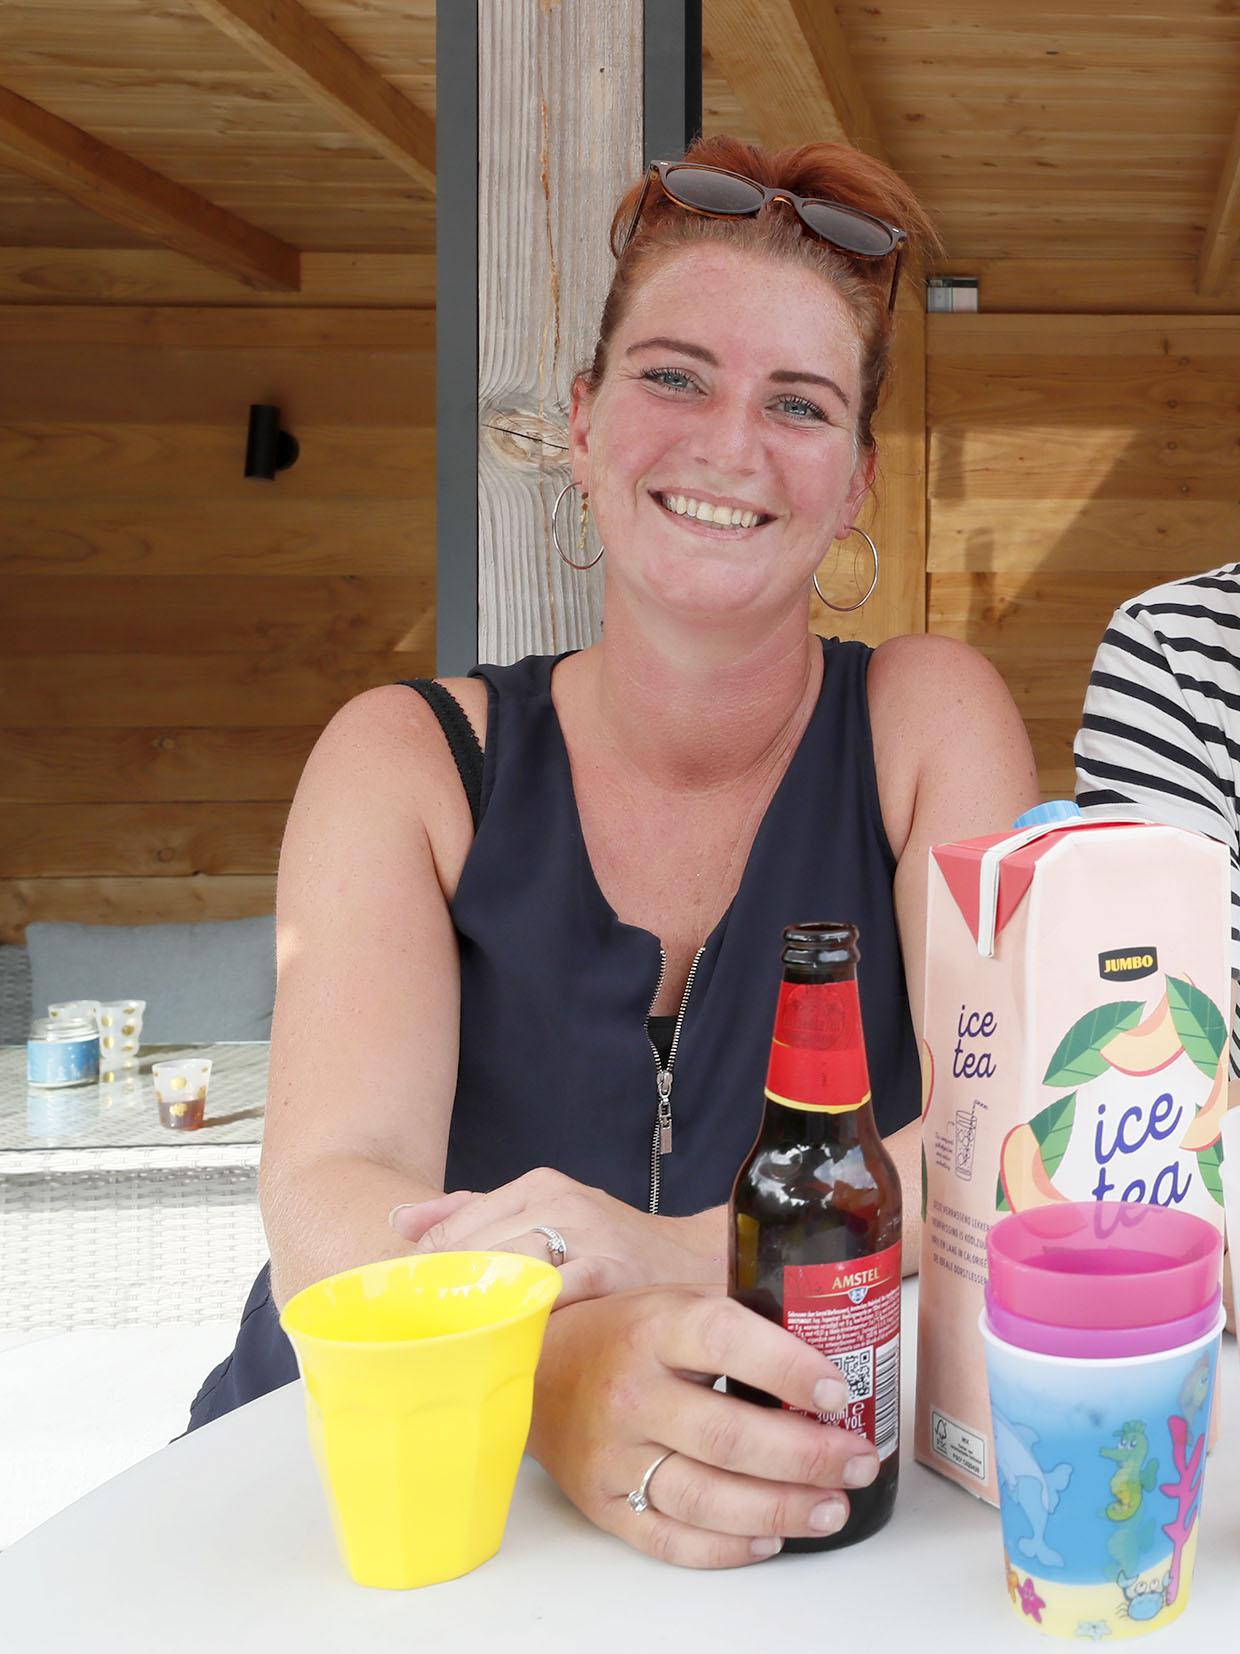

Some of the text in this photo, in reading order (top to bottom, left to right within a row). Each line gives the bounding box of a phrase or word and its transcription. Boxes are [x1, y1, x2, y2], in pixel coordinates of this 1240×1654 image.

[1103, 954, 1154, 974] JUMBO
[957, 1004, 998, 1038] ice
[952, 1039, 997, 1079] tea
[1094, 1093, 1183, 1165] ice
[1091, 1161, 1193, 1239] tea
[831, 1267, 880, 1290] AMSTEL
